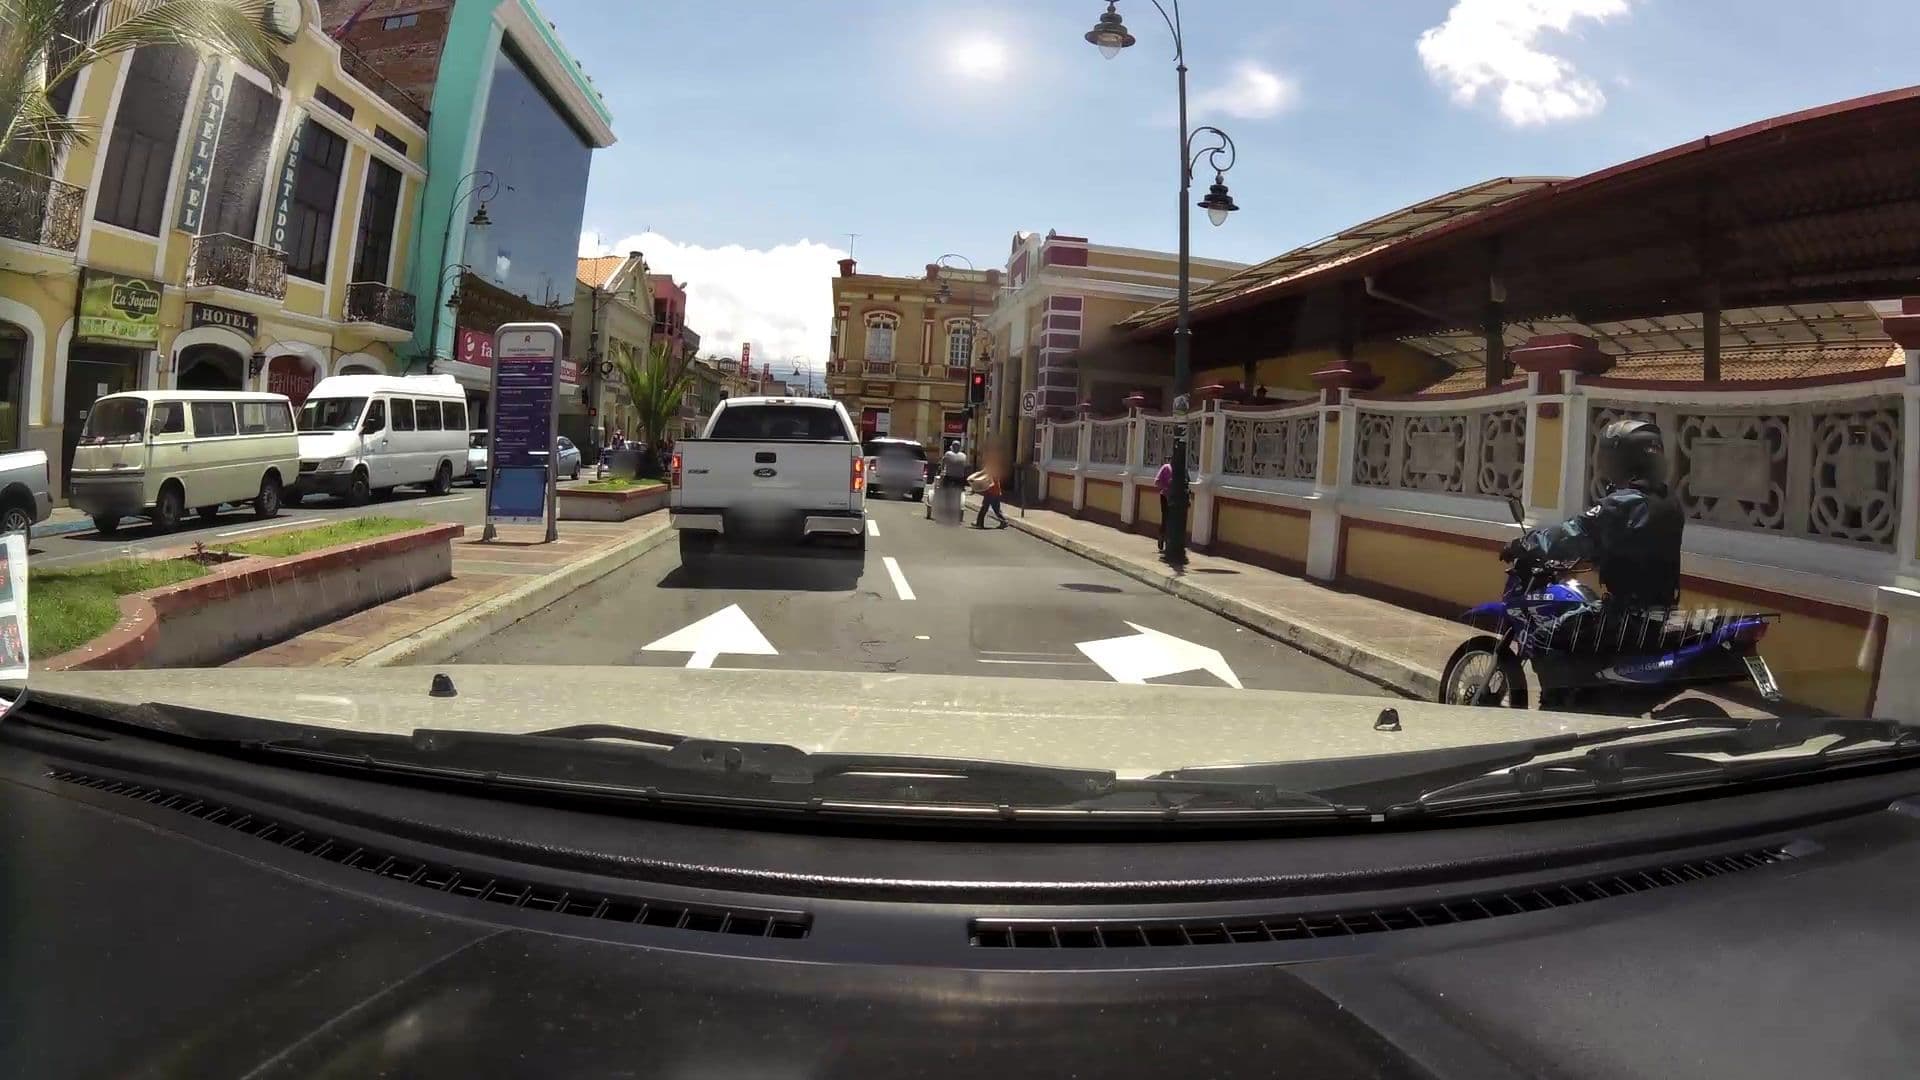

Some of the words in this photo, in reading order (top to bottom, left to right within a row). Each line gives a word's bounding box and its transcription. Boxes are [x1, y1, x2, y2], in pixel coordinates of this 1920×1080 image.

[114, 290, 127, 305] La
[202, 308, 249, 329] HOTEL
[742, 343, 750, 373] HOTEL
